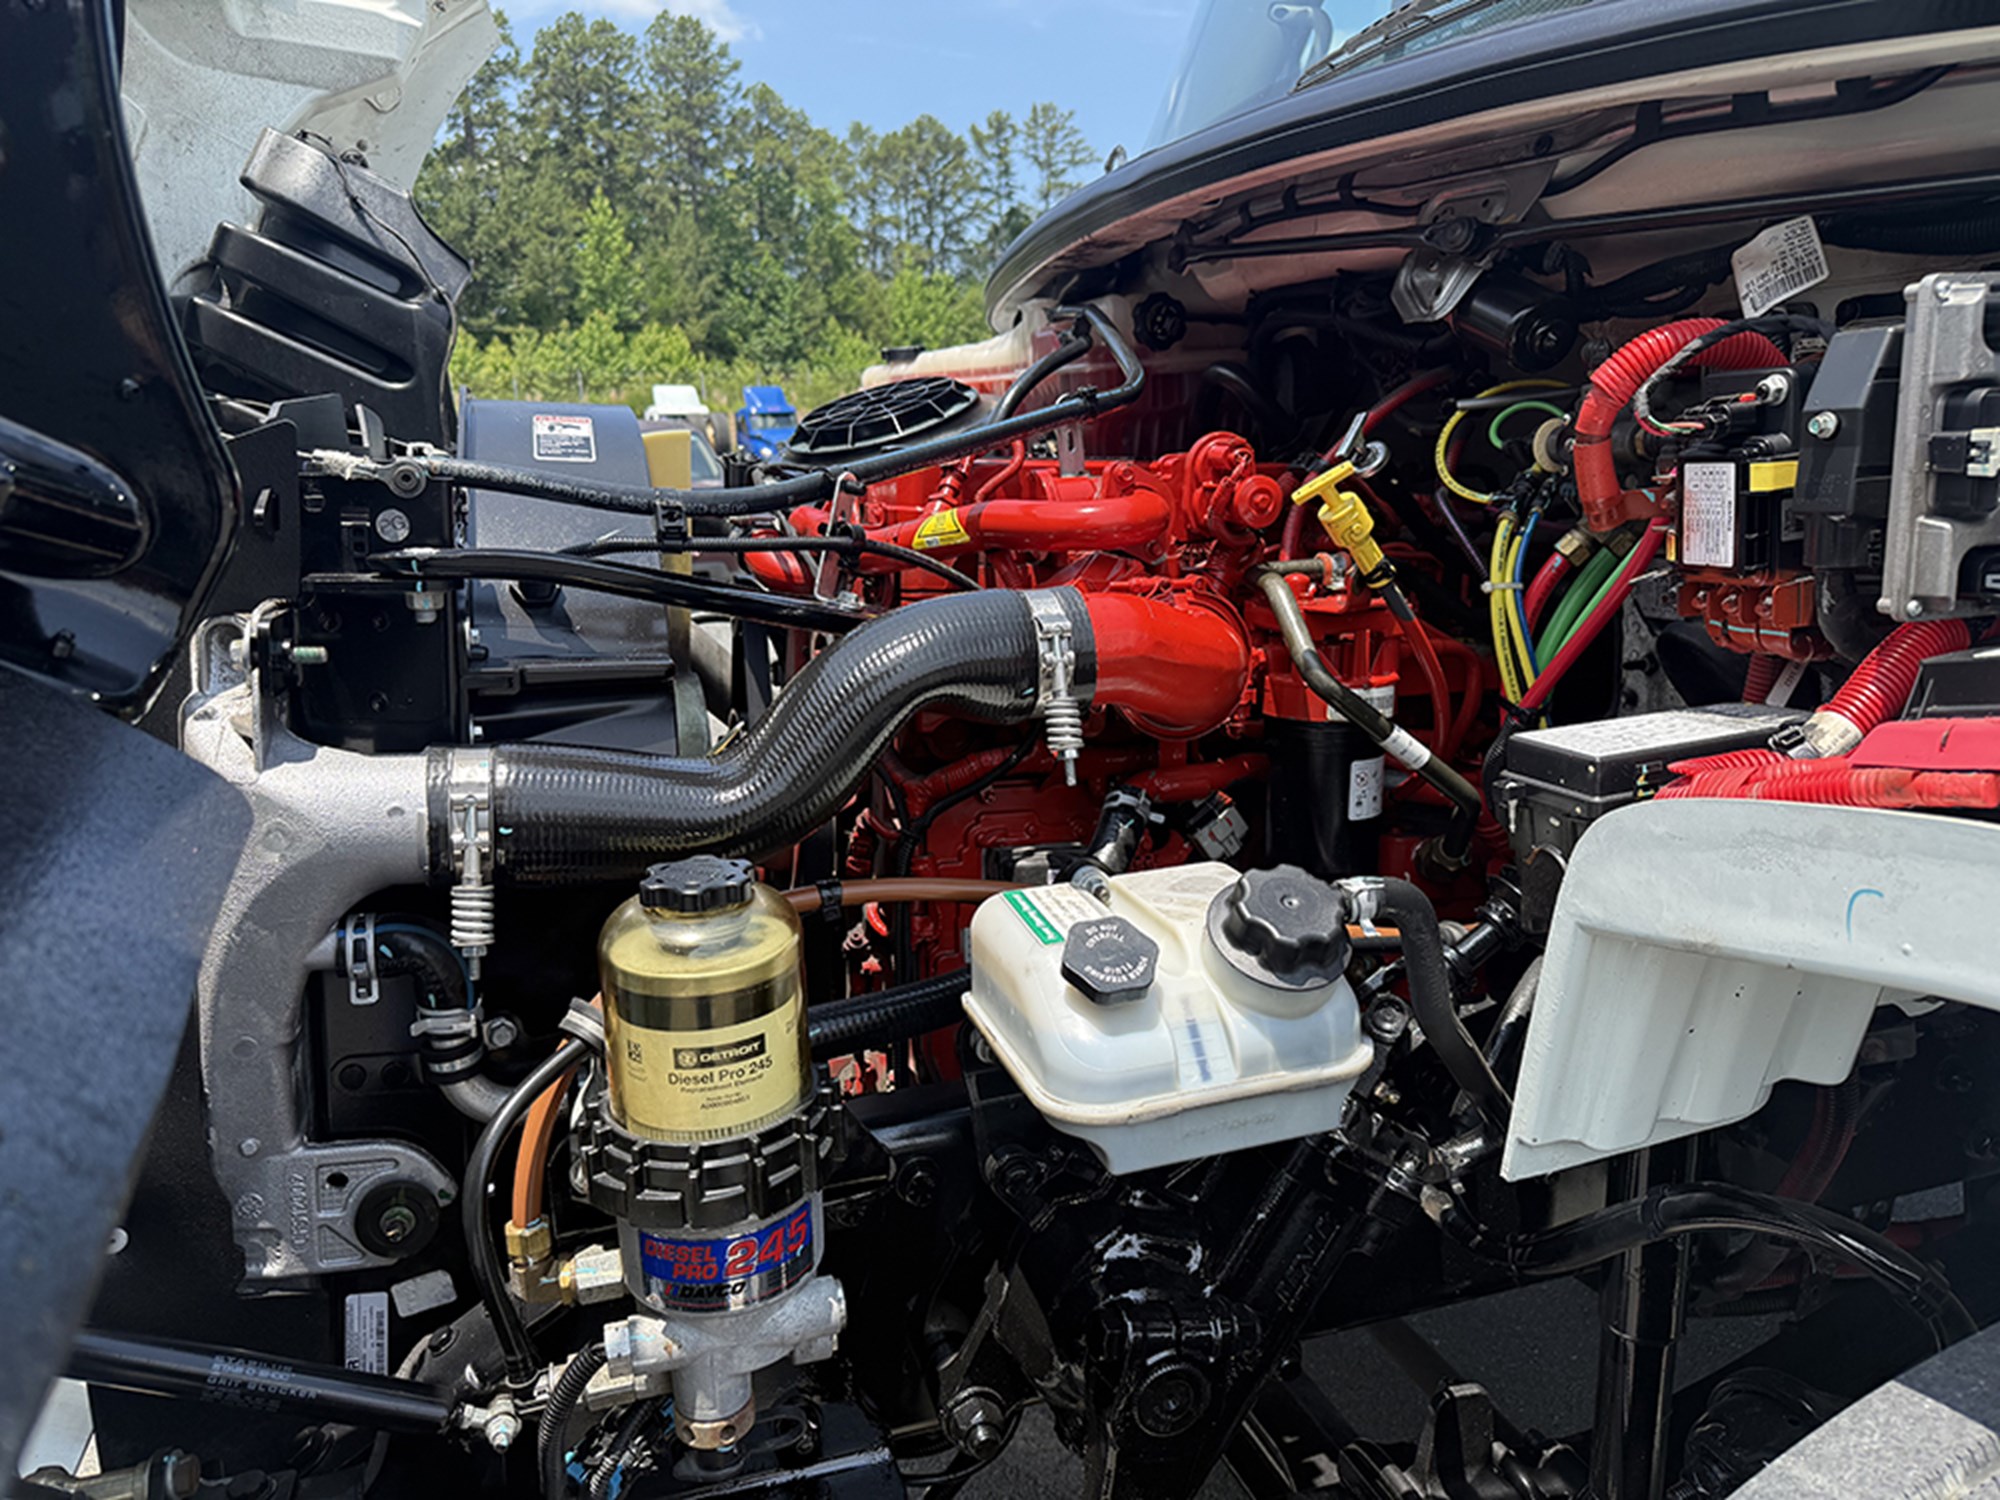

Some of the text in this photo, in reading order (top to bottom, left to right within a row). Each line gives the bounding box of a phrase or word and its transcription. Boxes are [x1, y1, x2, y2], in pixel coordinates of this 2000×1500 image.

[699, 1040, 762, 1063] DETROIT
[667, 1067, 715, 1086] Diesel
[748, 1056, 774, 1076] 245
[644, 1209, 809, 1280] DIESEL 245
[672, 1262, 719, 1281] PRO
[678, 1281, 746, 1299] DAVCO
